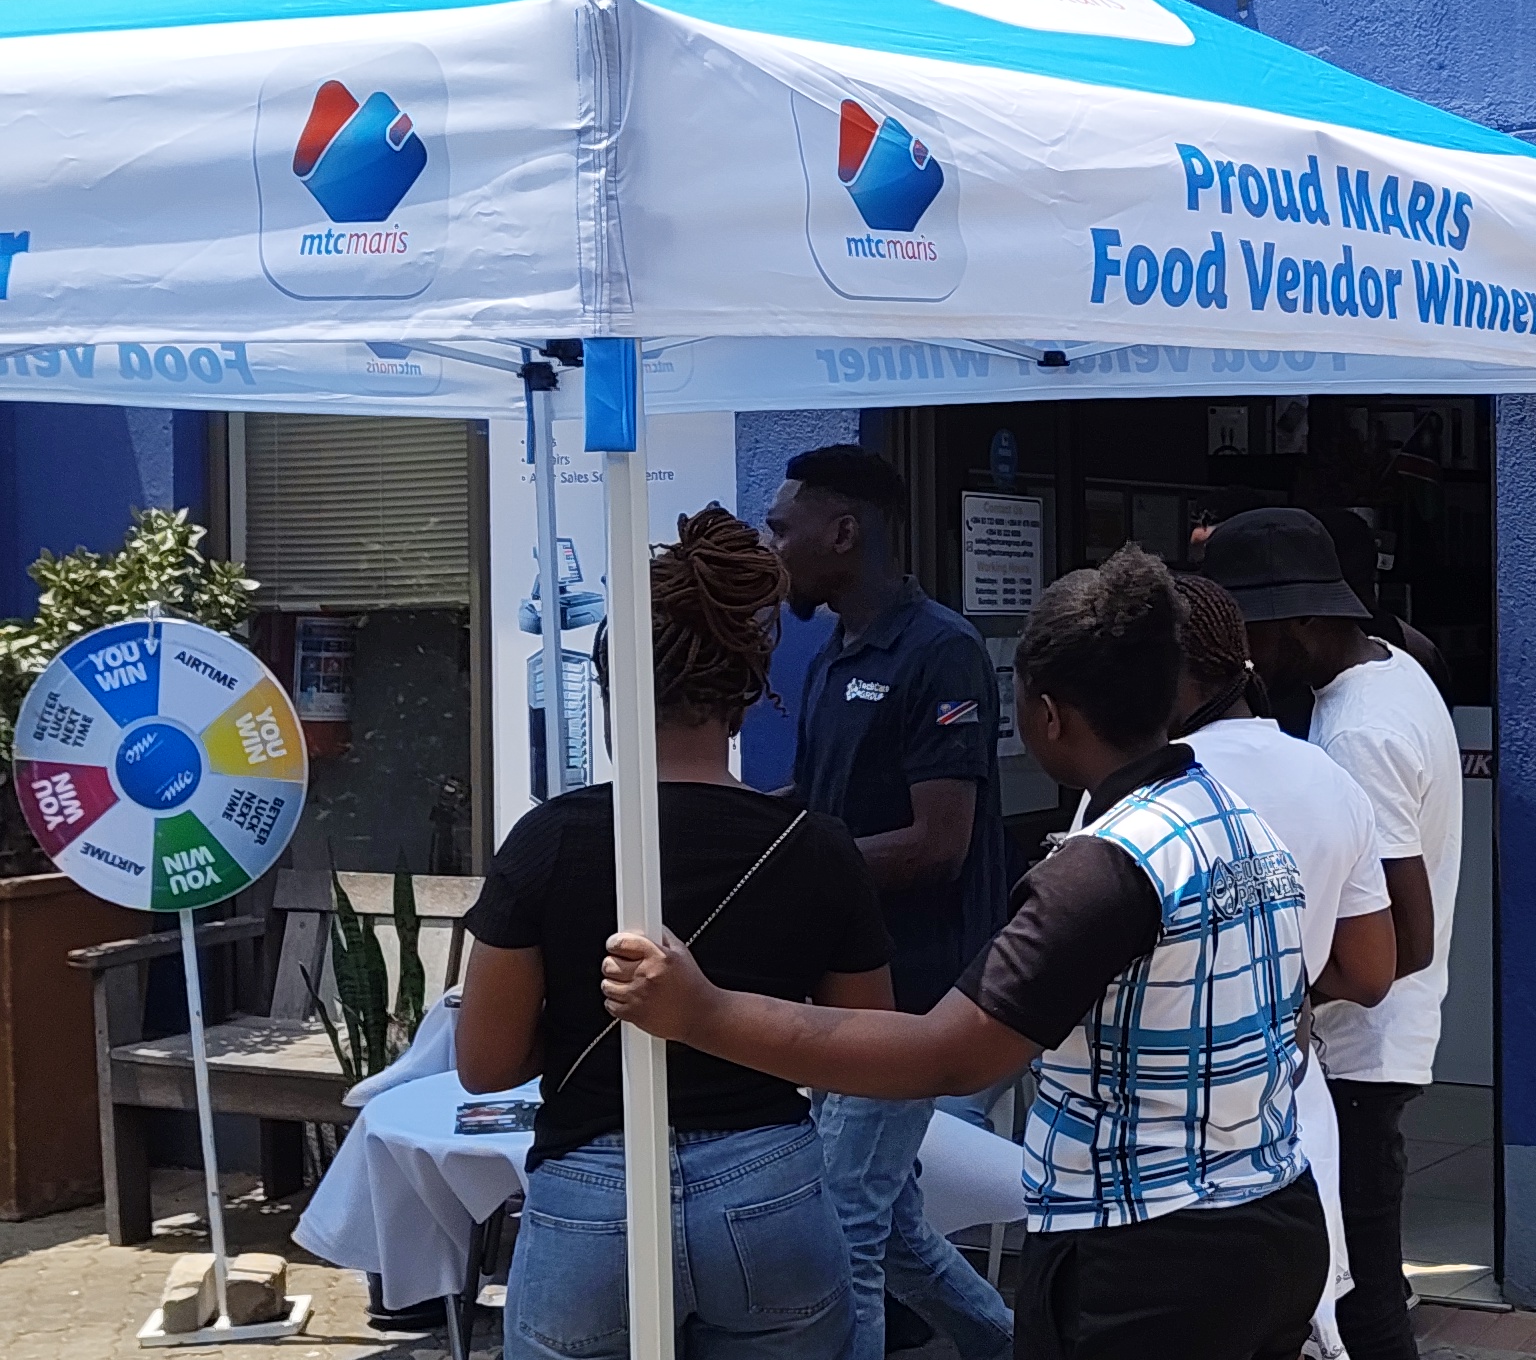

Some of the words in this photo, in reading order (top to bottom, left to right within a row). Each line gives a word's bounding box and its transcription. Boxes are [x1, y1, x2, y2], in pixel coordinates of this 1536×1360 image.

[1175, 142, 1329, 228] Proud
[1337, 163, 1474, 252] MARIS
[299, 224, 409, 257] mtcmaris
[845, 231, 938, 263] mtcmaris
[1090, 227, 1228, 310] Food
[1240, 246, 1403, 322] Vendor
[560, 471, 590, 484] Sales
[88, 640, 140, 672] YOU
[174, 651, 238, 690] AIRTIME
[95, 663, 147, 692] WIN
[33, 691, 61, 741] BETTER
[49, 705, 69, 739] LUCK
[60, 708, 82, 745] NEXT
[72, 715, 94, 748] TIME
[254, 706, 287, 760] YOU
[236, 712, 267, 765] WIN
[31, 780, 65, 832] YOU
[52, 771, 84, 825] WIN
[222, 788, 240, 821] TIME
[234, 791, 259, 828] NEXT
[246, 794, 269, 834] LUCK
[254, 797, 285, 846] BETTER
[80, 840, 146, 876] AIRTIME
[162, 845, 216, 874] WIN
[169, 865, 222, 895] YOU
